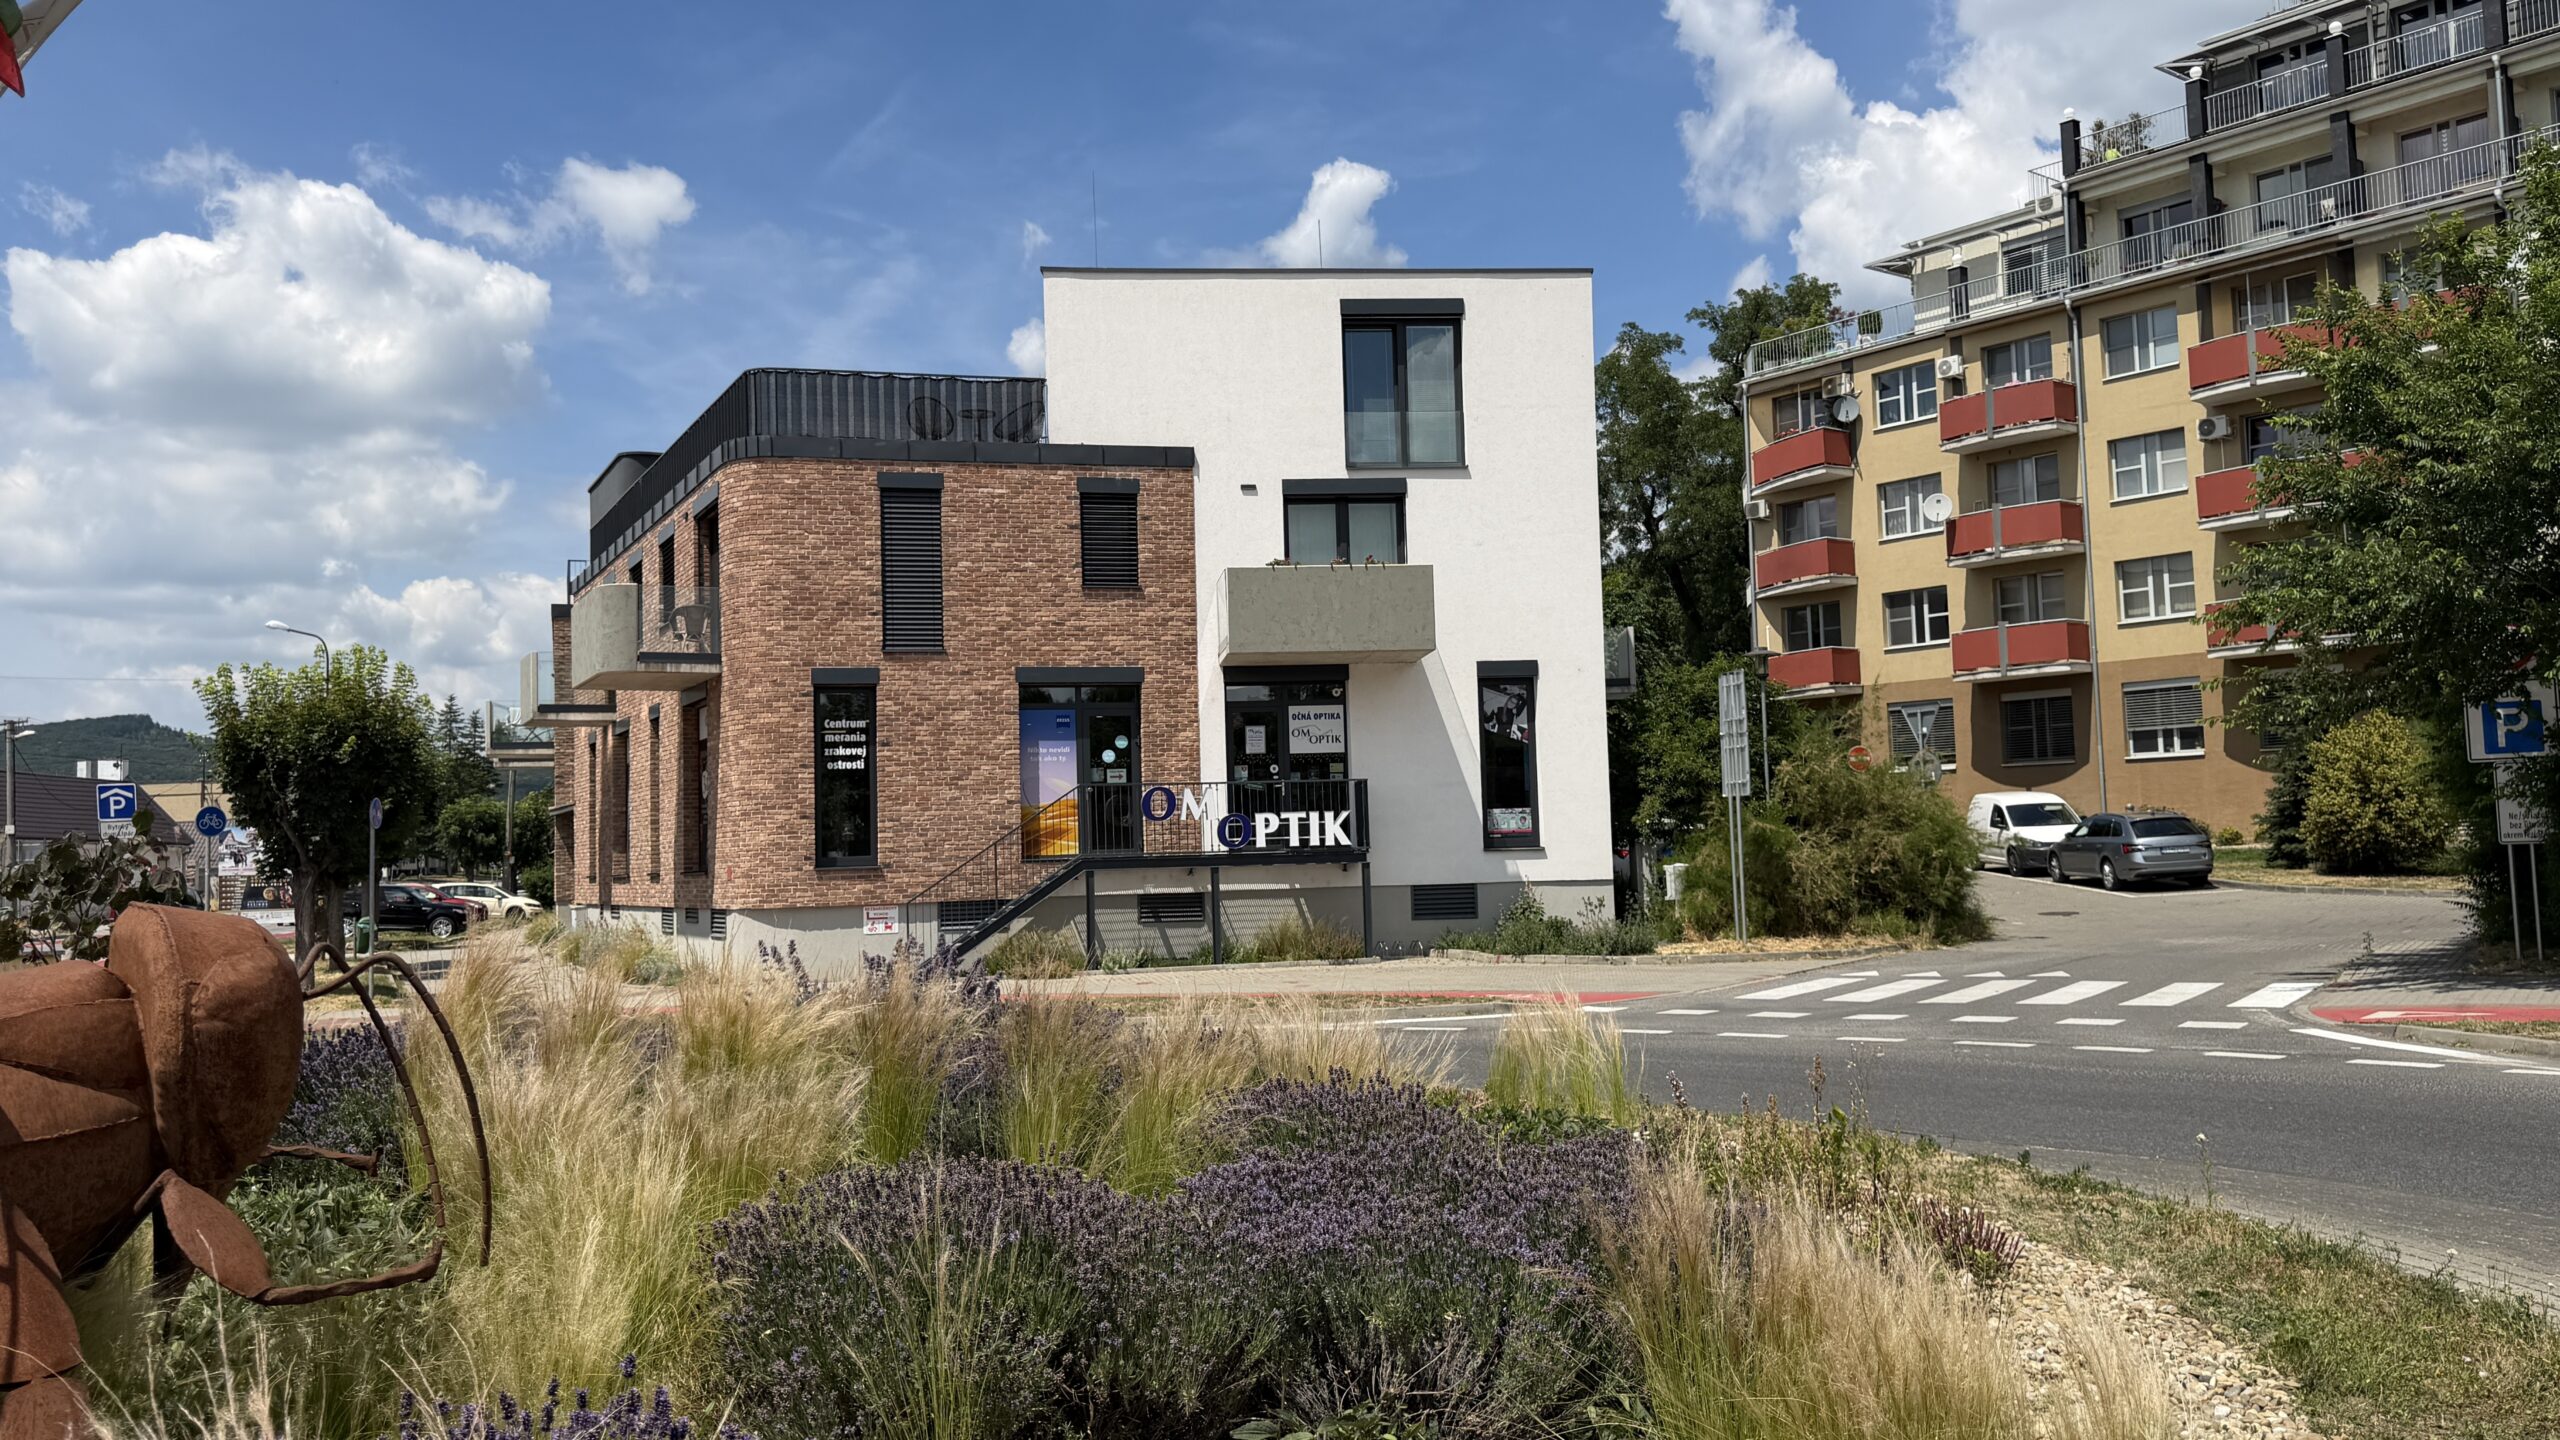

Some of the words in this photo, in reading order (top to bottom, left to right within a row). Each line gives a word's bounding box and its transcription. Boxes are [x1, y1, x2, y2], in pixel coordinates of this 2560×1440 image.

[1291, 711, 1312, 720] OČNÁ
[1313, 712, 1341, 720] OPTIKA
[824, 719, 866, 728] Centrum
[825, 731, 866, 742] merania
[1291, 728, 1310, 737] OM
[1309, 734, 1342, 744] OPTIK
[824, 745, 867, 758] zrakovej
[827, 758, 865, 769] ostrosti
[1141, 786, 1216, 821] OM
[1217, 809, 1352, 849] OPTIK
[2510, 821, 2522, 829] bez
